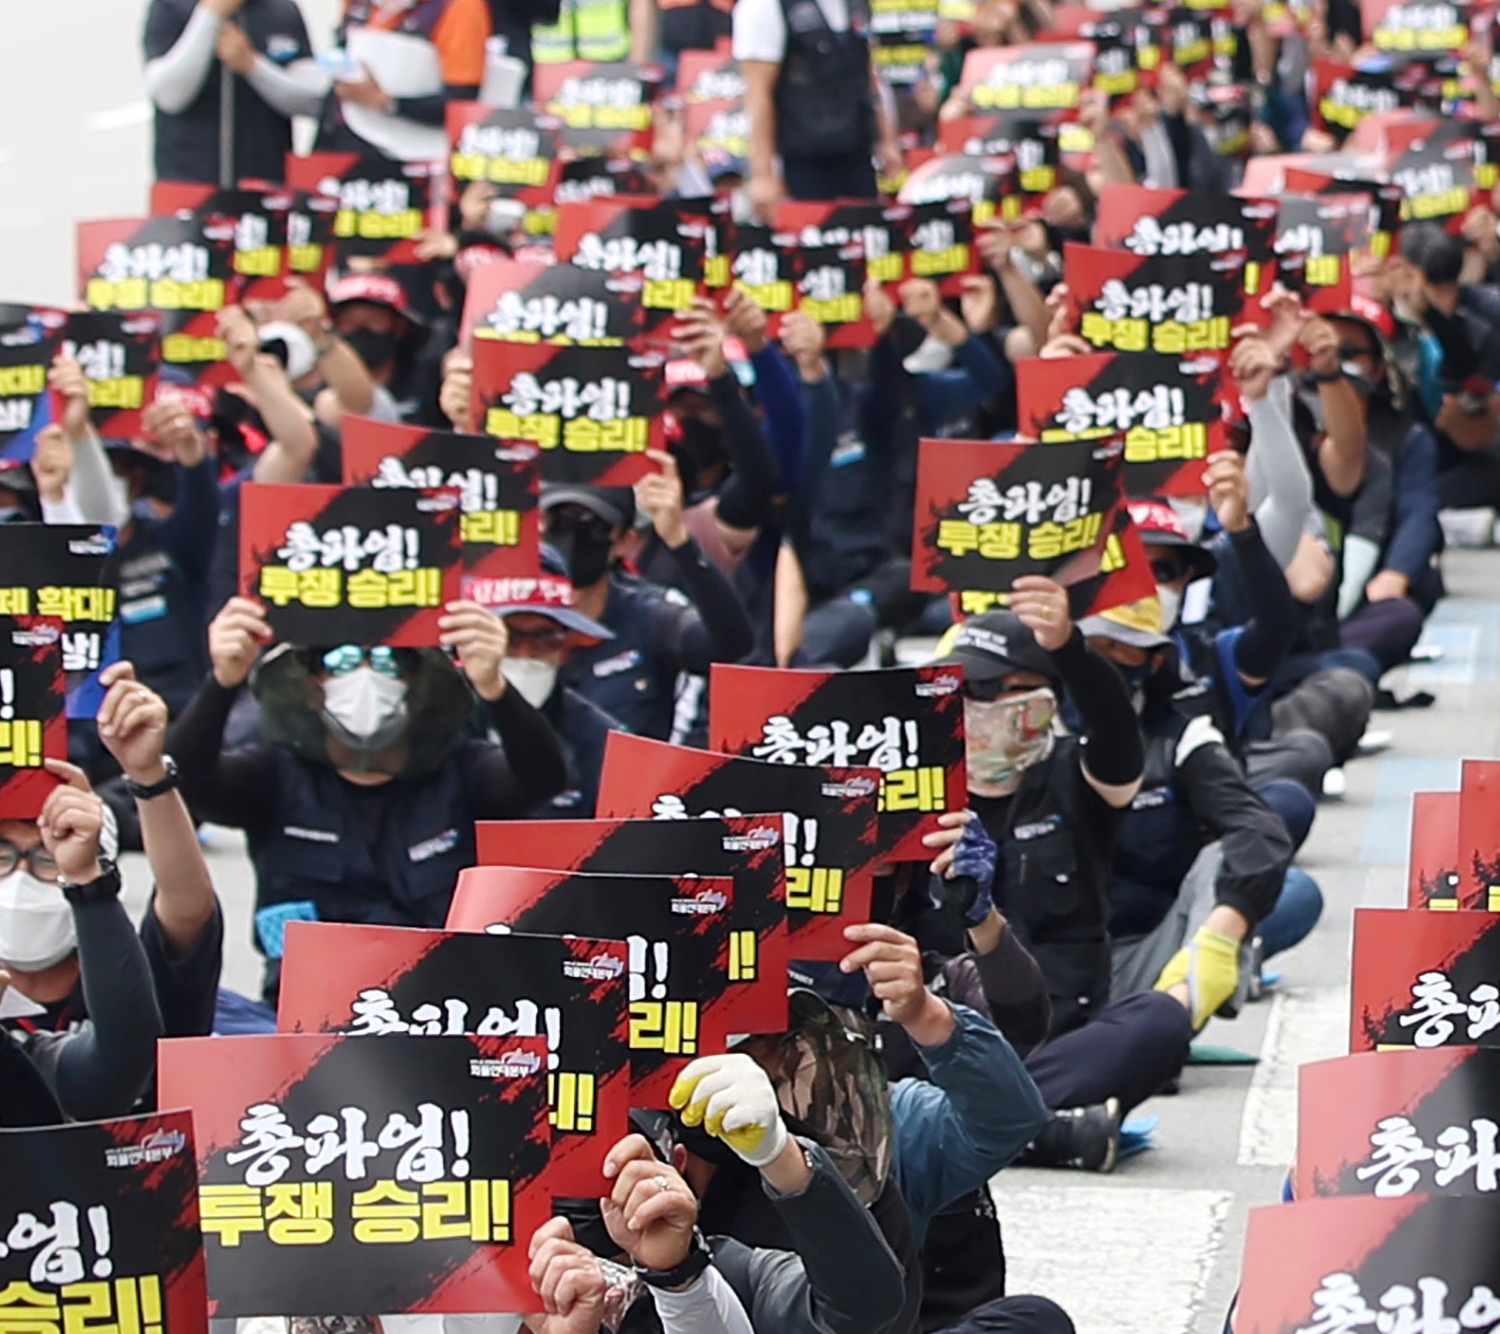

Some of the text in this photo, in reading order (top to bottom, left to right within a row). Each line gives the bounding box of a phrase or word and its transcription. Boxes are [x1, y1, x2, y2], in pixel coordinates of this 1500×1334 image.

[1096, 281, 1211, 323] 총파업!
[1081, 312, 1230, 353] 투쟁 승리!
[503, 372, 628, 419] 총파업!
[1056, 386, 1183, 433] 총파업!
[485, 407, 648, 452] 투쟁 승리!
[1124, 422, 1206, 462] 승리!
[959, 478, 1089, 525] 총파업!
[278, 522, 417, 572] 총파업!
[937, 513, 1102, 559] 투쟁 승리!
[260, 566, 442, 607] 투쟁 승리!
[754, 717, 917, 768] 총파업!
[224, 1104, 469, 1187] 총파업!
[200, 1180, 509, 1244] 투쟁 승리!
